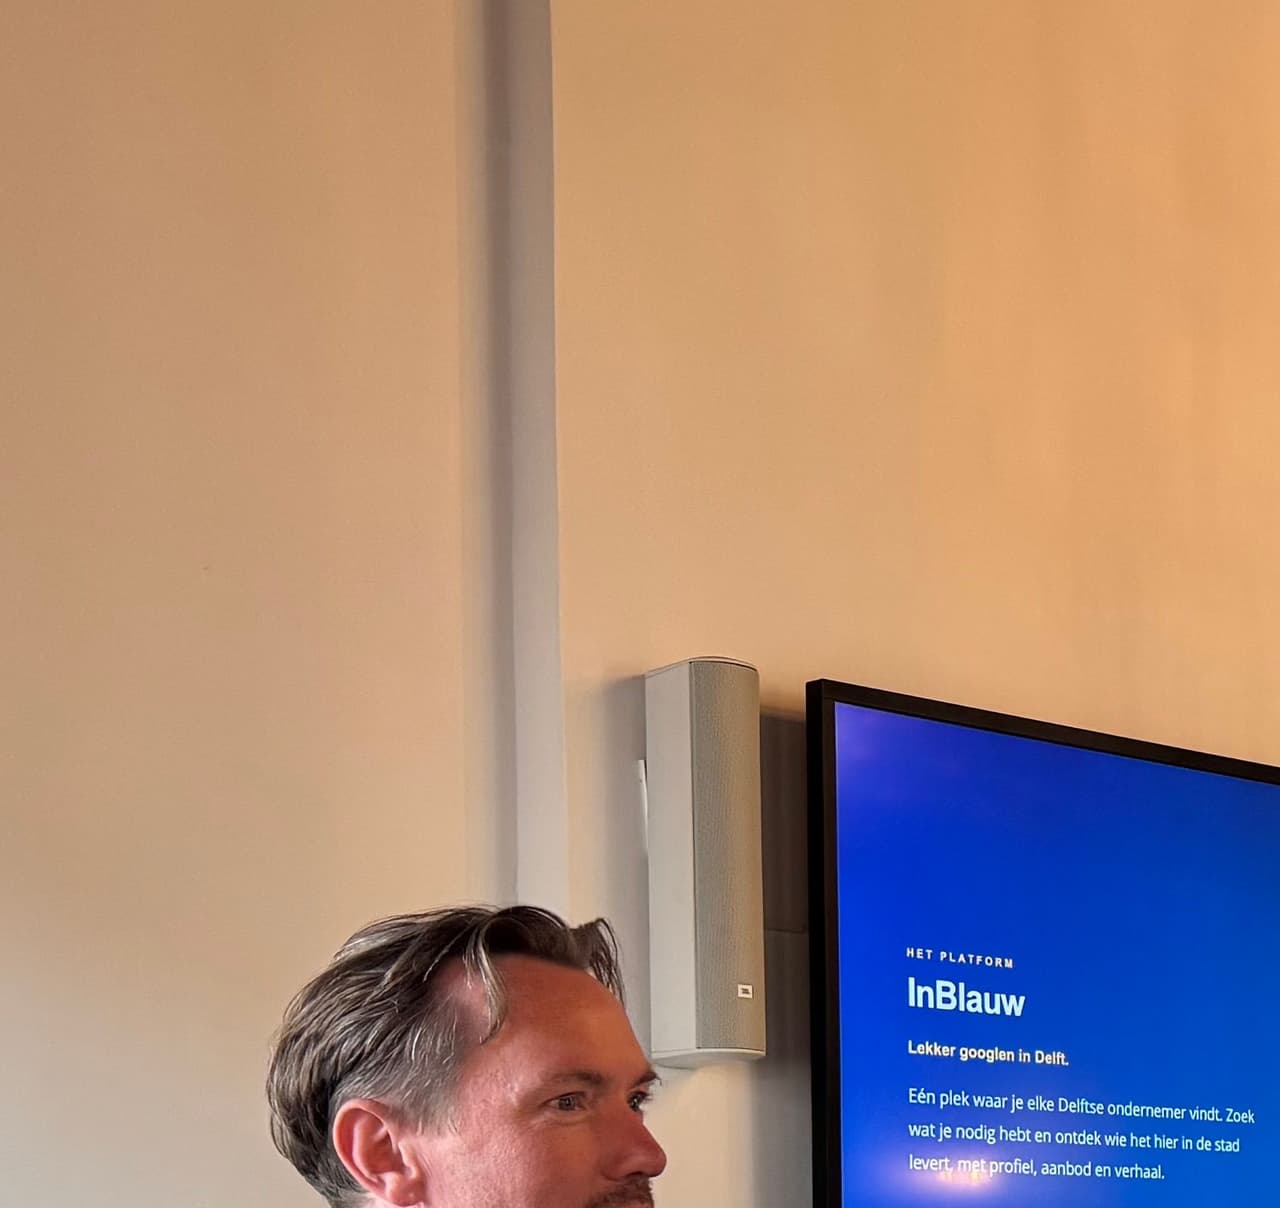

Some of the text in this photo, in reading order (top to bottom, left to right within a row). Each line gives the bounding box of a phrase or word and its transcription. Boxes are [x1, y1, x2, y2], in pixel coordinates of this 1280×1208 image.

[906, 947, 1014, 969] HET PLATFORM
[907, 976, 1026, 1017] InBlauw
[908, 1039, 1069, 1066] Lekker googlen in Delft.
[908, 1087, 1255, 1124] Eén plek waar je elke Delftse ondernemer vindt. Zoek
[908, 1122, 1240, 1153] wat je nodig hebt en ontdek wie het hier in de stad
[909, 1153, 1165, 1180] levert, met profiel, aanbod en verhaal.
